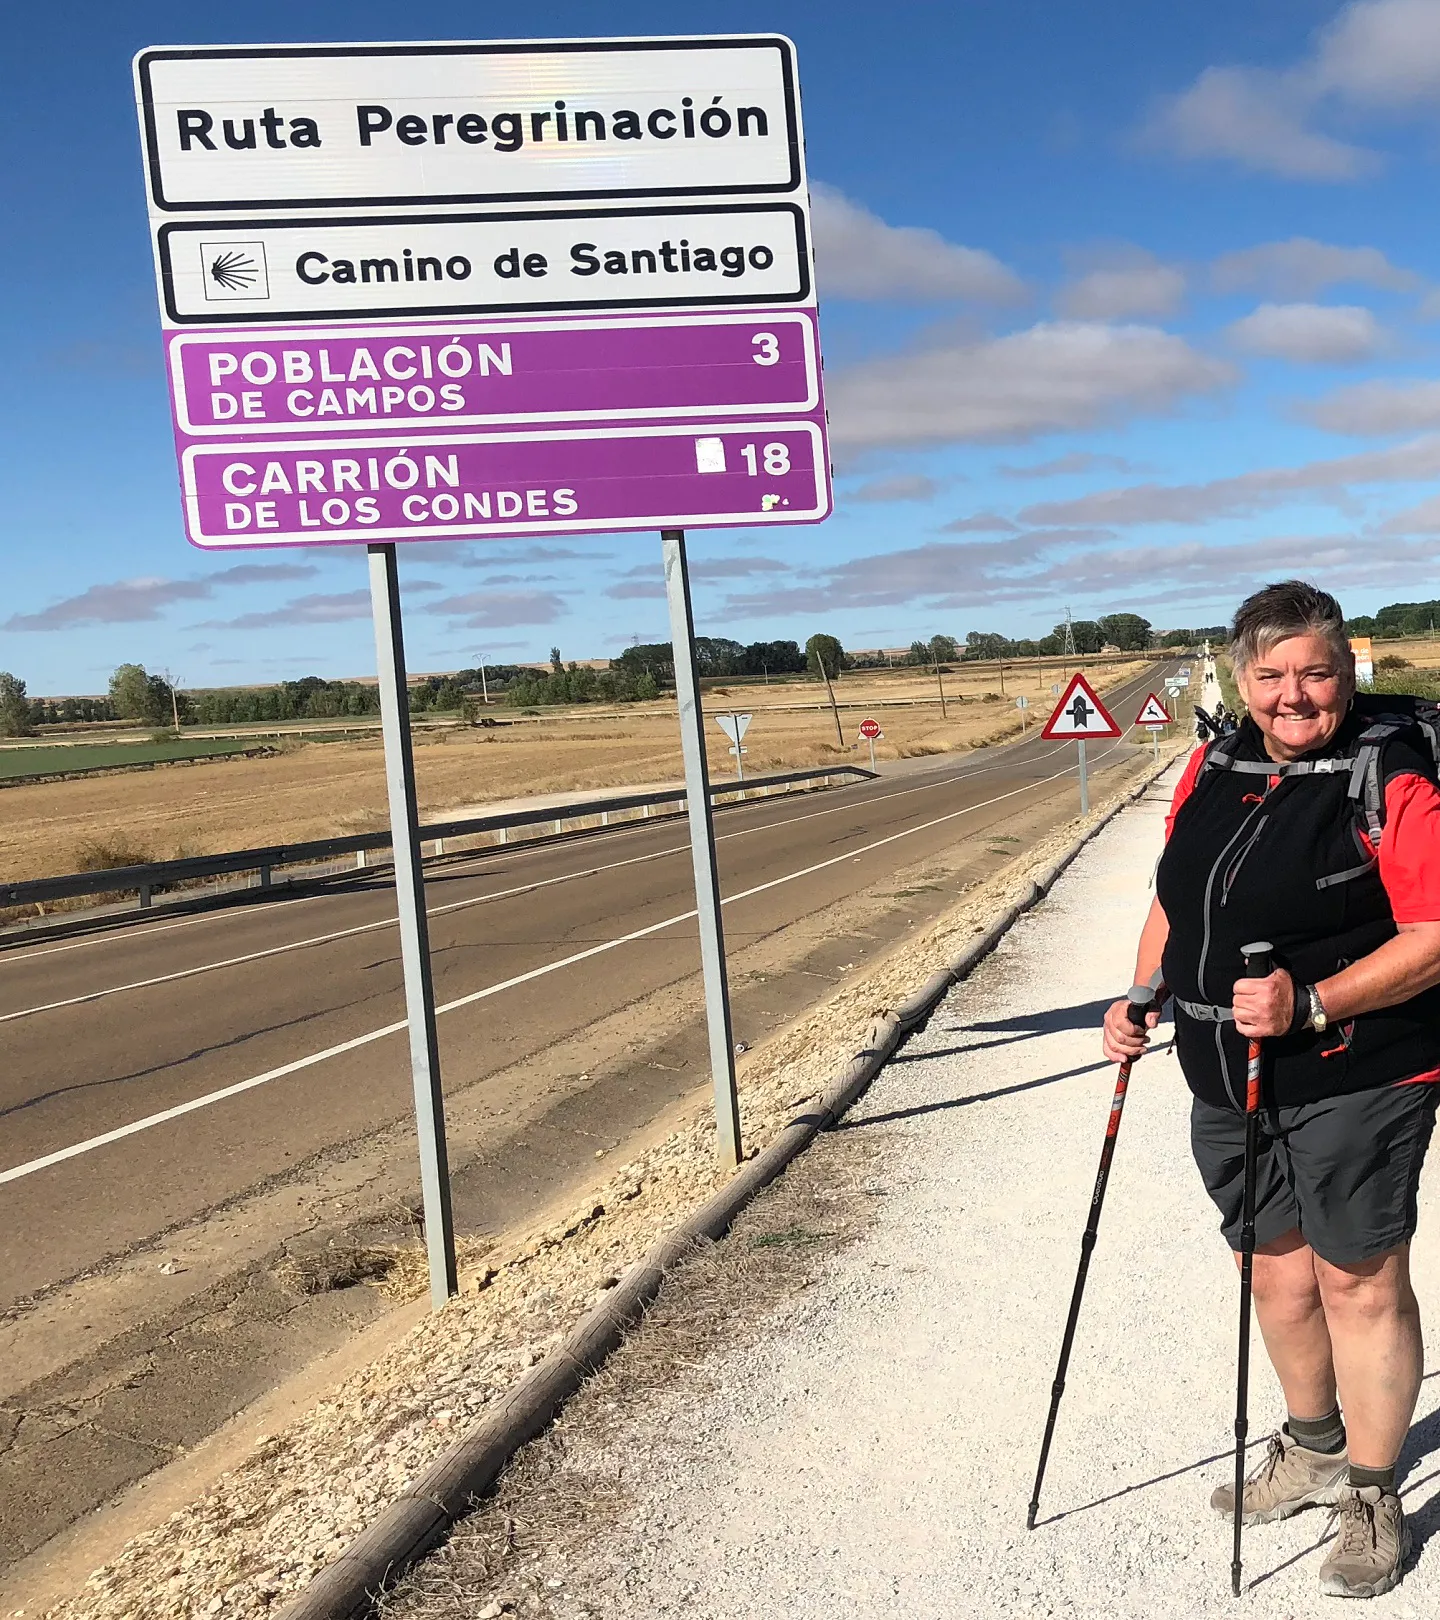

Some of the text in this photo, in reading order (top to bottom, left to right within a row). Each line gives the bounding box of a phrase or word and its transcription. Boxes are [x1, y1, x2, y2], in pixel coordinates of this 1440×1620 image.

[176, 96, 769, 152] Ruta Peregrinación
[295, 240, 774, 285] Camino de Santiago
[208, 332, 780, 387] POBLACIÓN 3
[210, 383, 466, 420] DE CAMPOS
[222, 442, 791, 497] CARRIÓN 18
[225, 488, 578, 530] DE LOS CONDES
